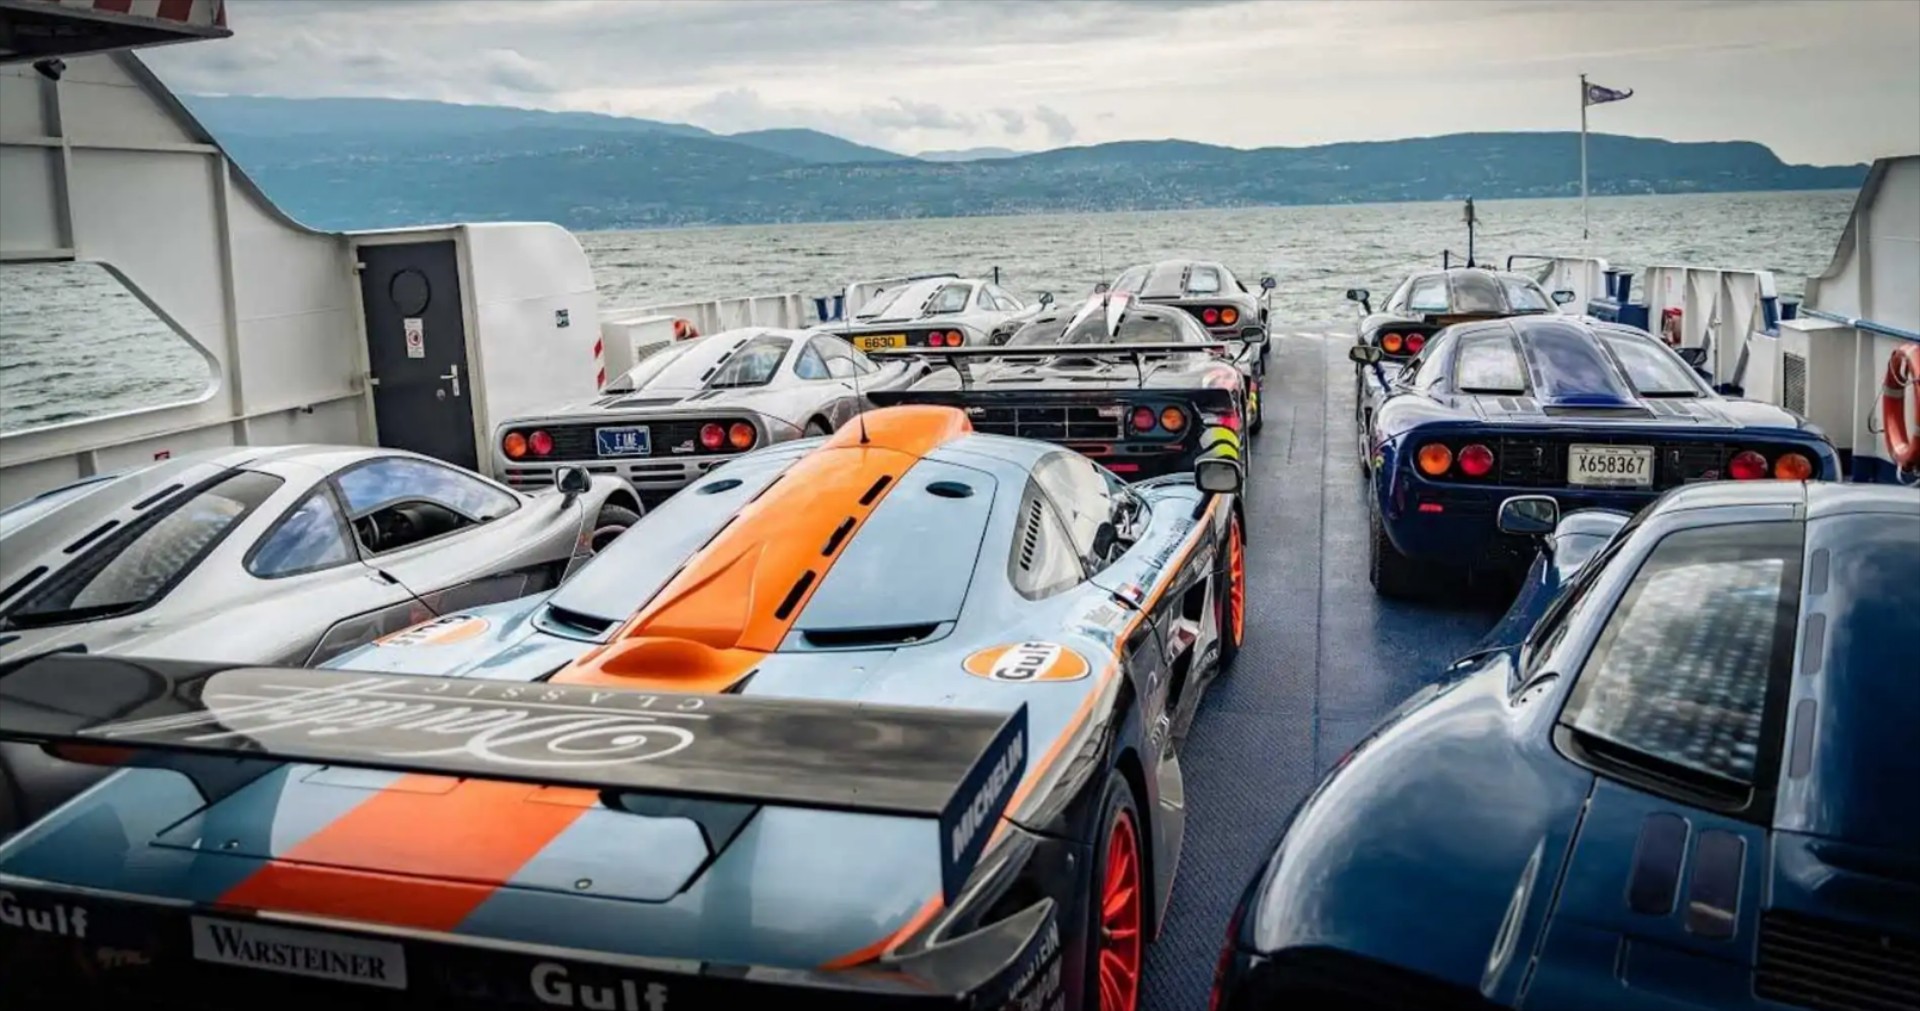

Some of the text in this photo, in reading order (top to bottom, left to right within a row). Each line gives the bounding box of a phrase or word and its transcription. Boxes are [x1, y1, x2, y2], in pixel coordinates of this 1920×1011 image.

[1579, 455, 1645, 474] X658367
[995, 643, 1056, 681] Gulf
[423, 682, 705, 711] CLASSIC
[952, 729, 1024, 864] MICHELIN
[0, 890, 89, 938] Gulf
[209, 924, 387, 981] WARSTEINER
[530, 961, 670, 1011] Gulf
